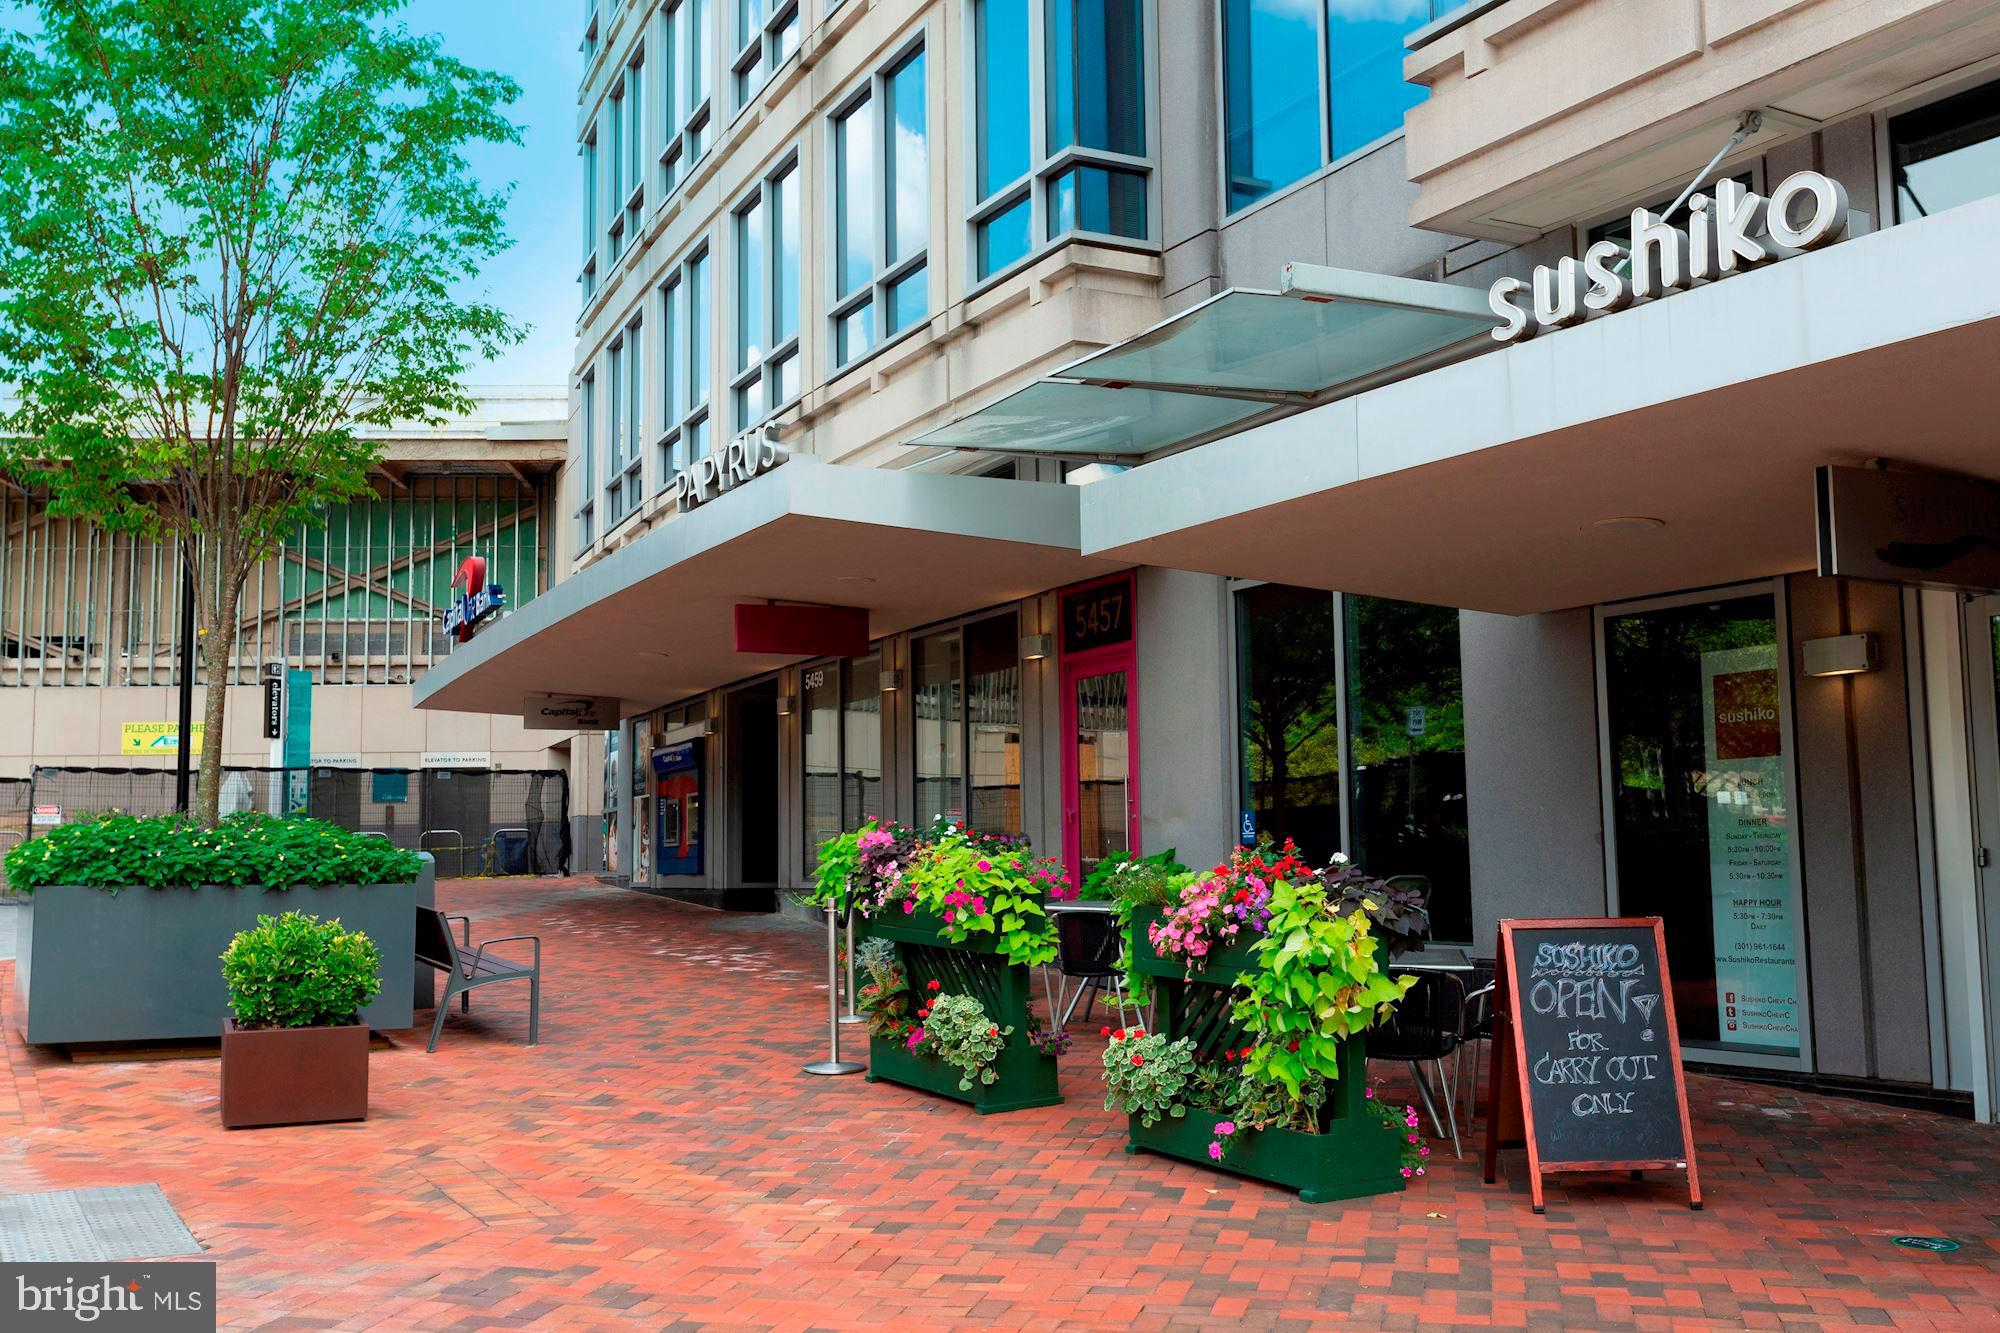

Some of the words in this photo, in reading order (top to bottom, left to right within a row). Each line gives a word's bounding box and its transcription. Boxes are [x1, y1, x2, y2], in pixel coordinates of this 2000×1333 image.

[1489, 170, 1848, 342] sushiko
[677, 419, 789, 513] PAPYRUS
[1075, 594, 1124, 638] 5457
[805, 670, 824, 690] 5459
[270, 682, 281, 726] elevators
[1719, 707, 1776, 724] sushiko
[124, 724, 165, 733] PLEASE
[1738, 818, 1768, 826] DINNER
[1733, 899, 1757, 907] HAPPY
[1759, 899, 1782, 907] HOUR
[1734, 942, 1753, 951] (301)
[1754, 943, 1786, 951] 961-1644
[1568, 1029, 1609, 1051] FOR
[1533, 1052, 1601, 1085] CARRY
[1606, 1055, 1658, 1081] OUT
[1572, 1092, 1635, 1116] ONLY
